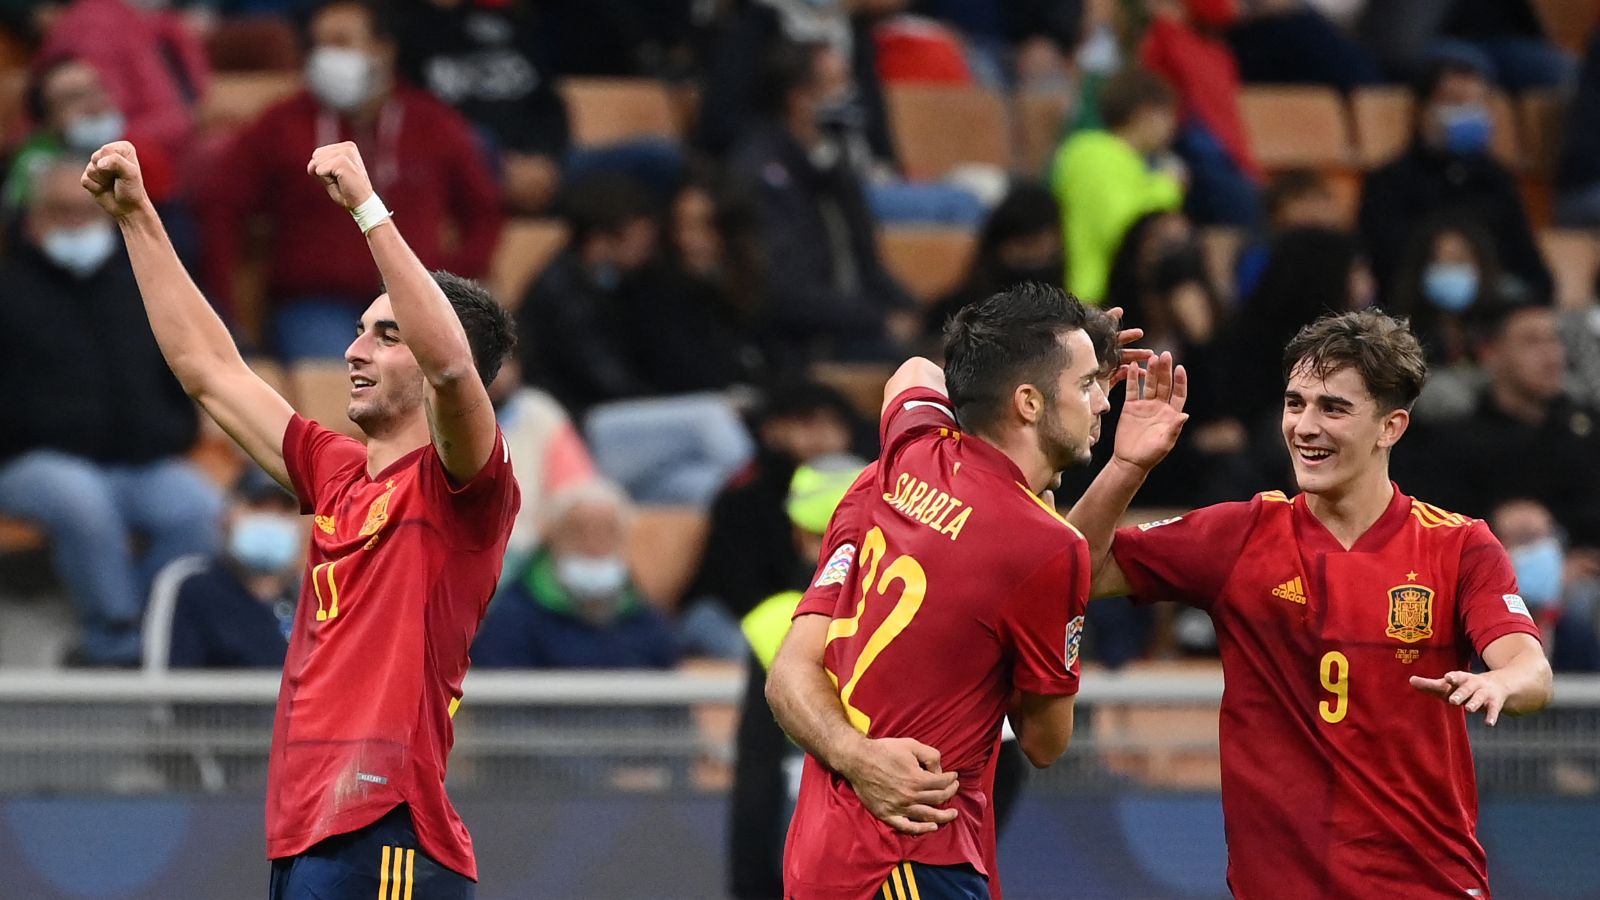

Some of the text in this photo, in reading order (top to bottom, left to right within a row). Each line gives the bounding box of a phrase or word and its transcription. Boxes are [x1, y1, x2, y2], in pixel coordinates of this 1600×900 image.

[882, 472, 973, 541] SARABIA
[312, 562, 339, 621] 11
[1271, 587, 1307, 605] adidas
[824, 525, 928, 736] 22
[1318, 650, 1349, 724] 9
